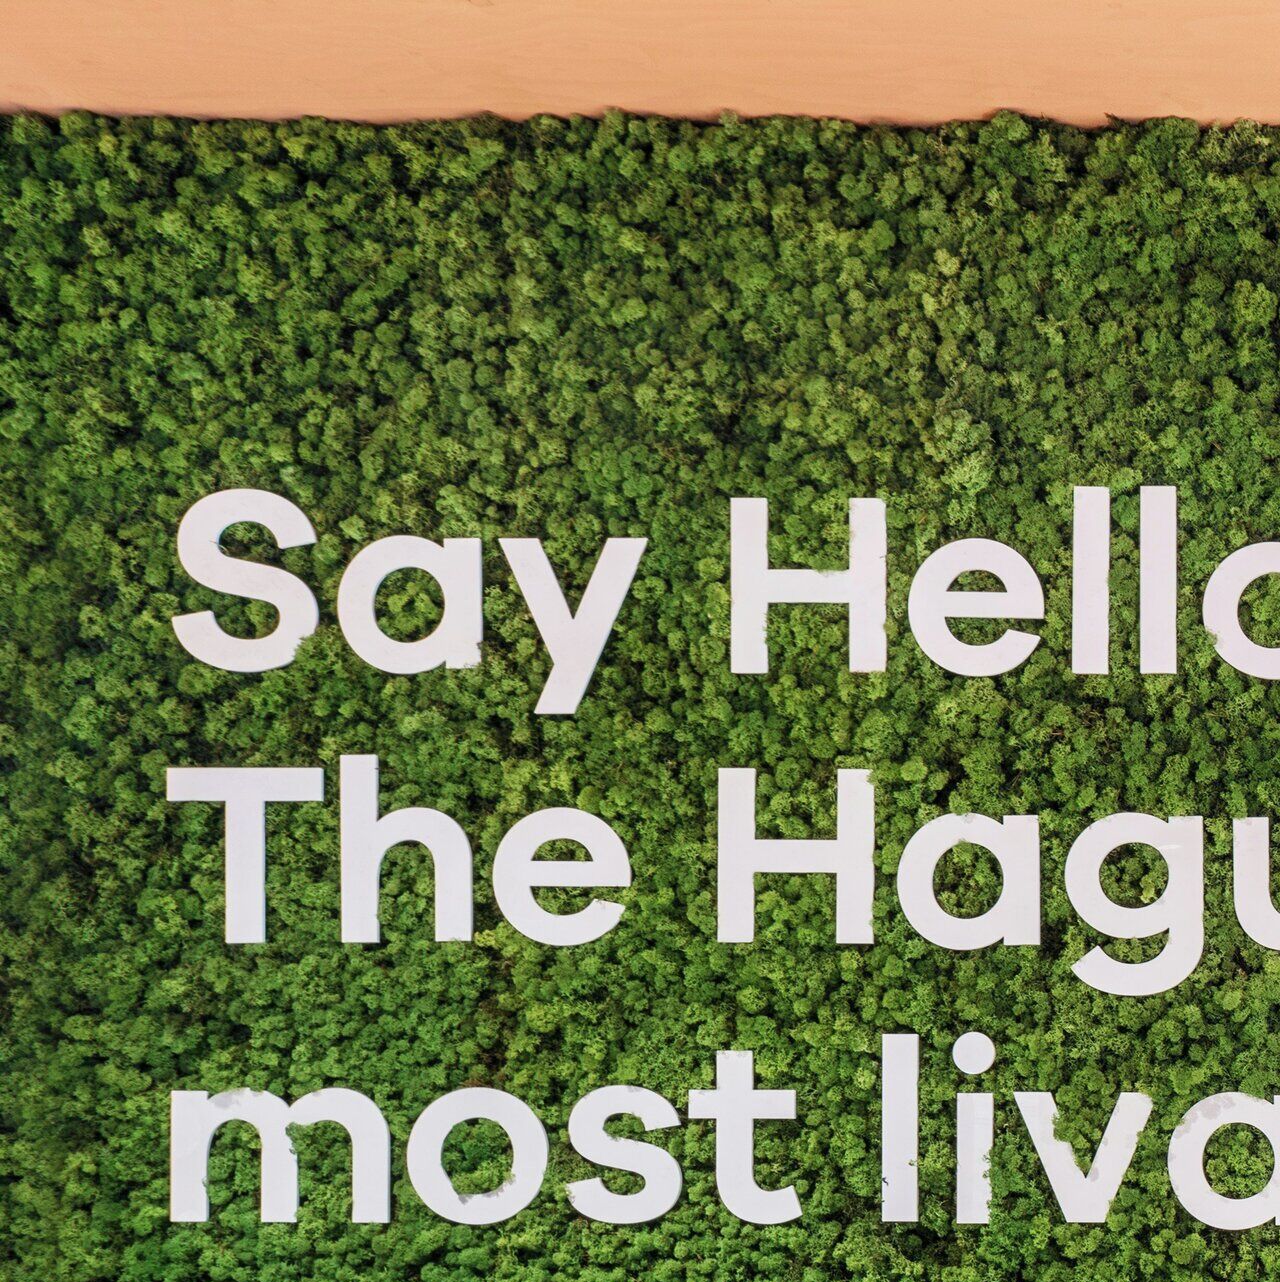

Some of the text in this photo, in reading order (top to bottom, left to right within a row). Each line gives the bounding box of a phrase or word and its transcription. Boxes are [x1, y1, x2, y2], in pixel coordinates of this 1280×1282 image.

[172, 488, 649, 715] Say
[166, 754, 632, 947] The
[170, 1049, 803, 1225] most
